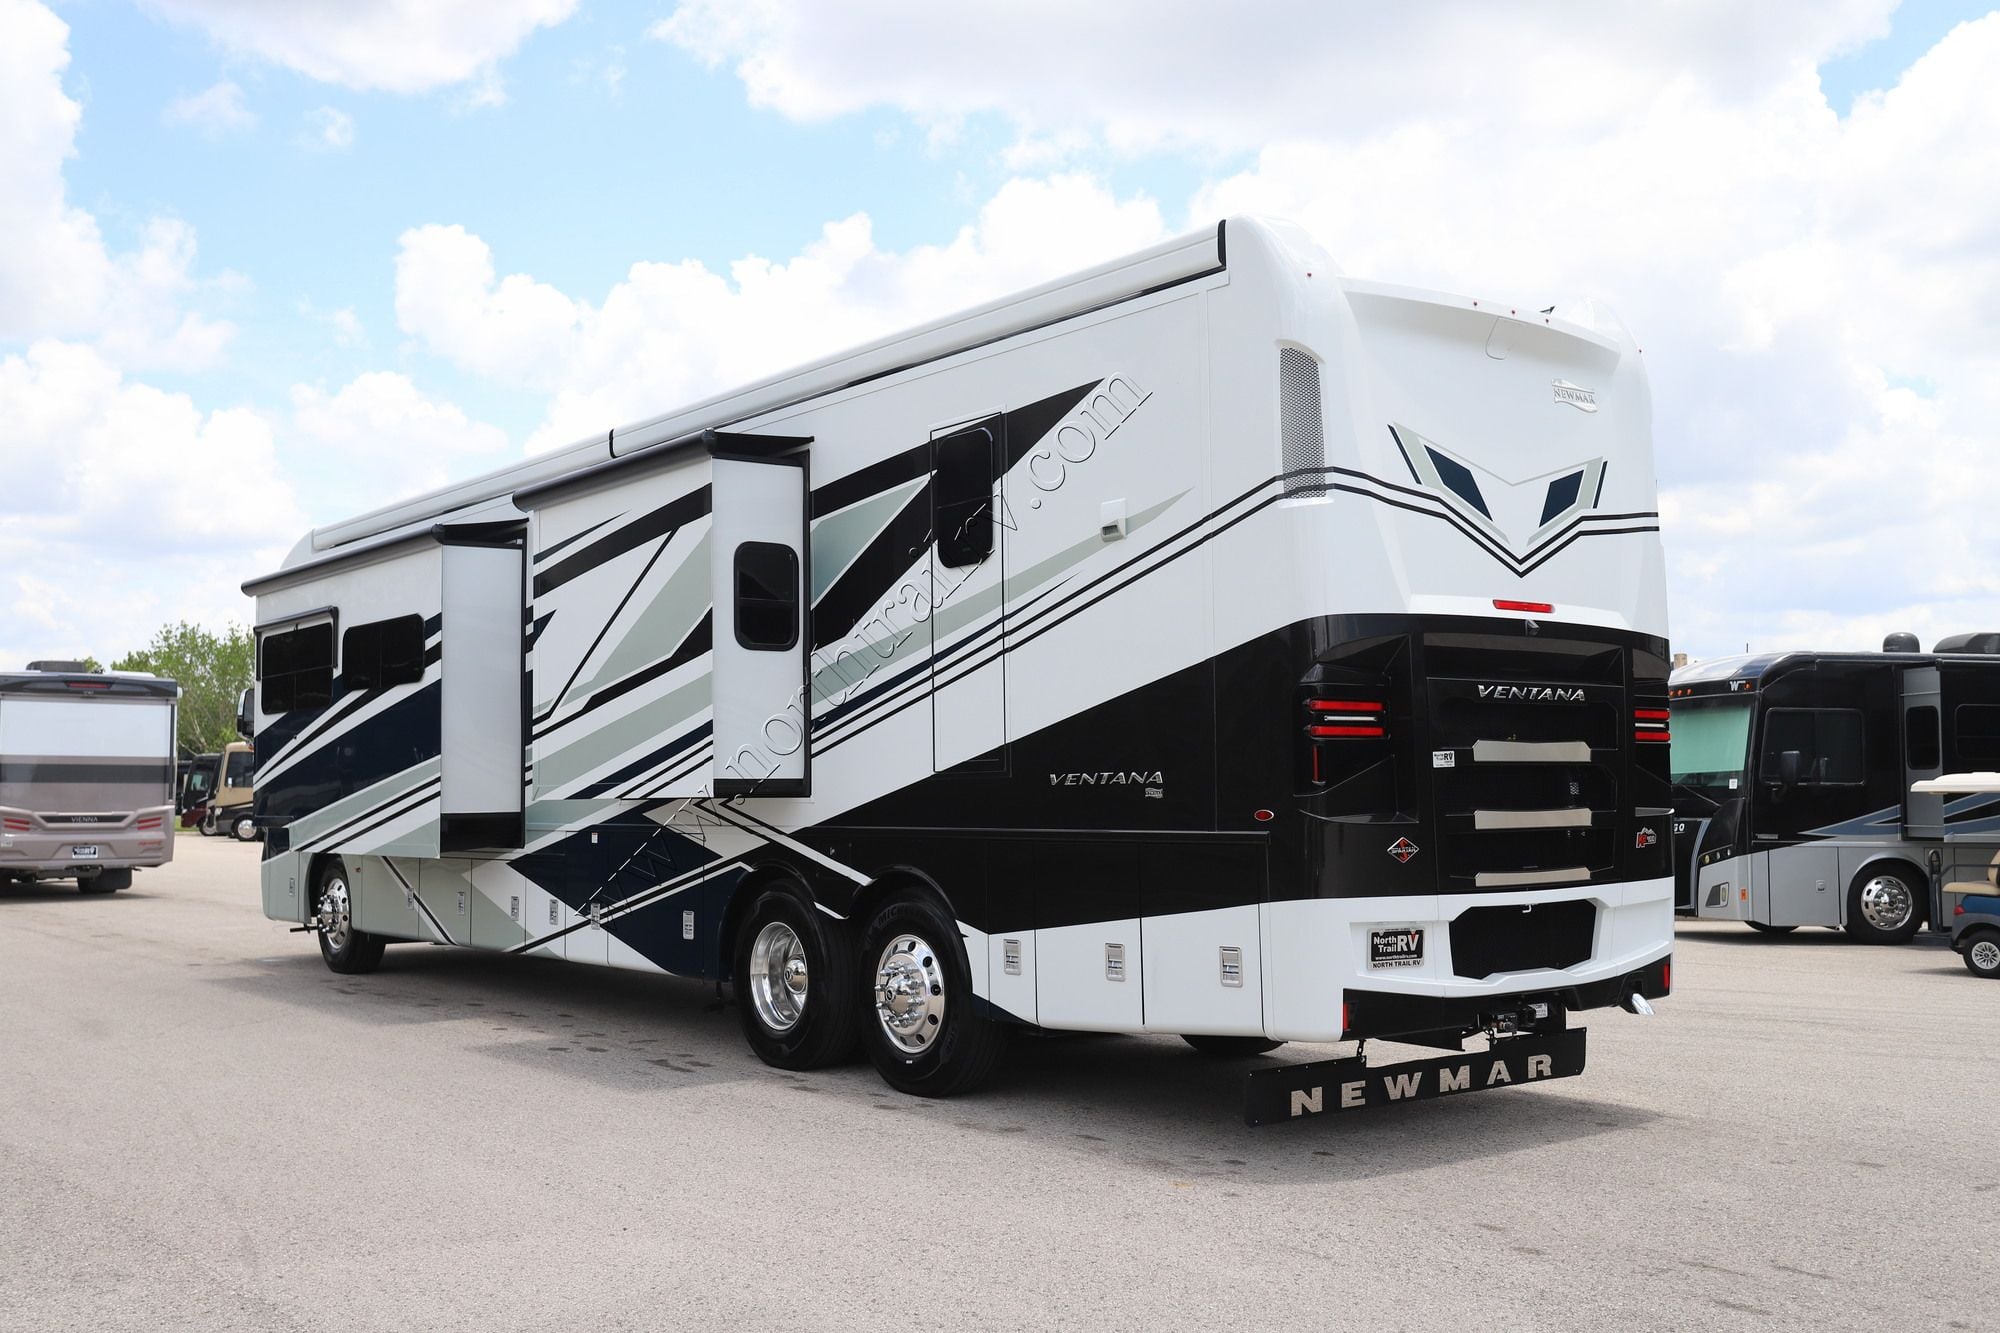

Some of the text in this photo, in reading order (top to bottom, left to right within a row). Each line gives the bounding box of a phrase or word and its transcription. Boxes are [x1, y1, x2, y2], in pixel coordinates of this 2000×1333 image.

[1553, 387, 1596, 405] NEWMAR
[1477, 684, 1585, 701] VENTANA
[1049, 771, 1163, 786] VENTANA
[1373, 936, 1396, 944] North
[1378, 944, 1396, 952] Trail
[1397, 935, 1419, 951] RV
[1290, 1054, 1552, 1117] NEWMAR
